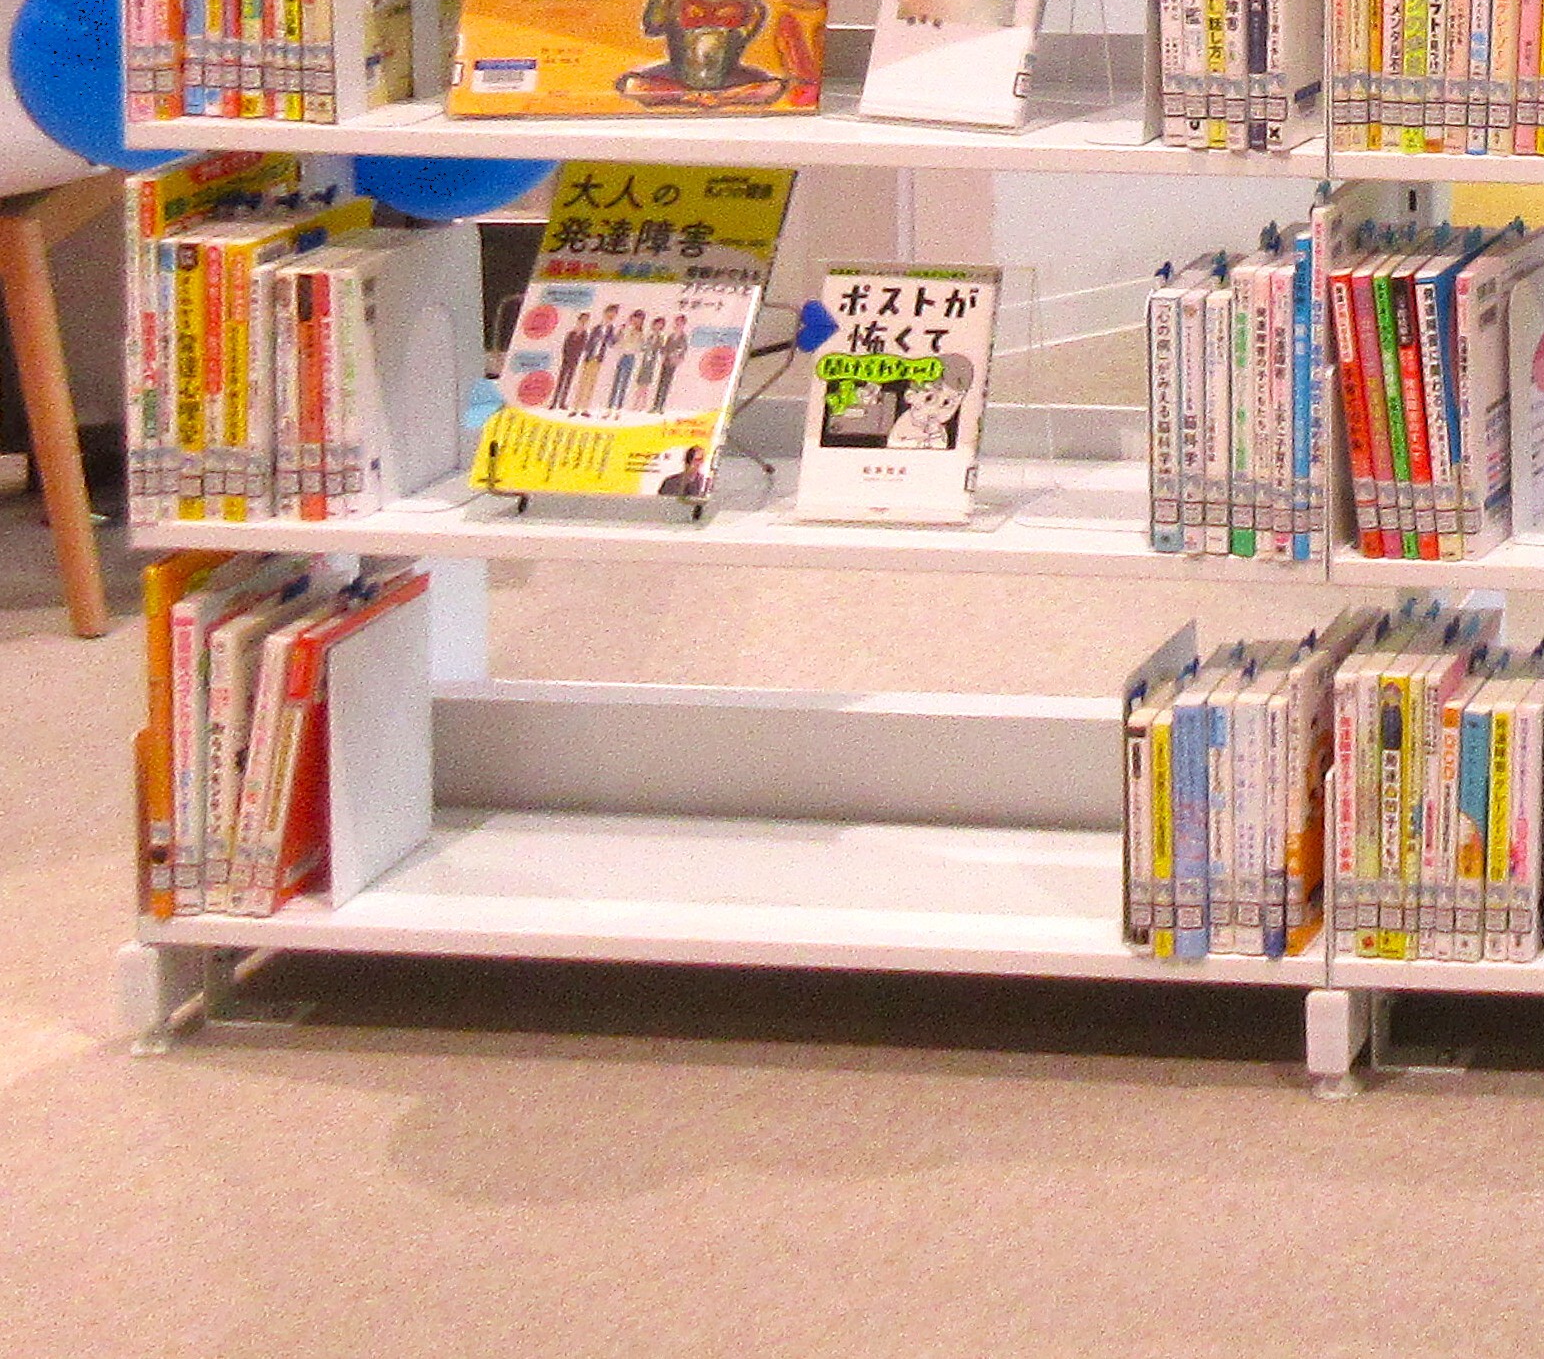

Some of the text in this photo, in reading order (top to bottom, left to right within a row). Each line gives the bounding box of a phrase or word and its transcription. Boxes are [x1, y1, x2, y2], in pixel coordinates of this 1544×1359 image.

[563, 174, 681, 209] 大人の
[549, 217, 715, 259] 発達障害
[838, 284, 979, 319] ポストが
[847, 320, 950, 354] 怖くて
